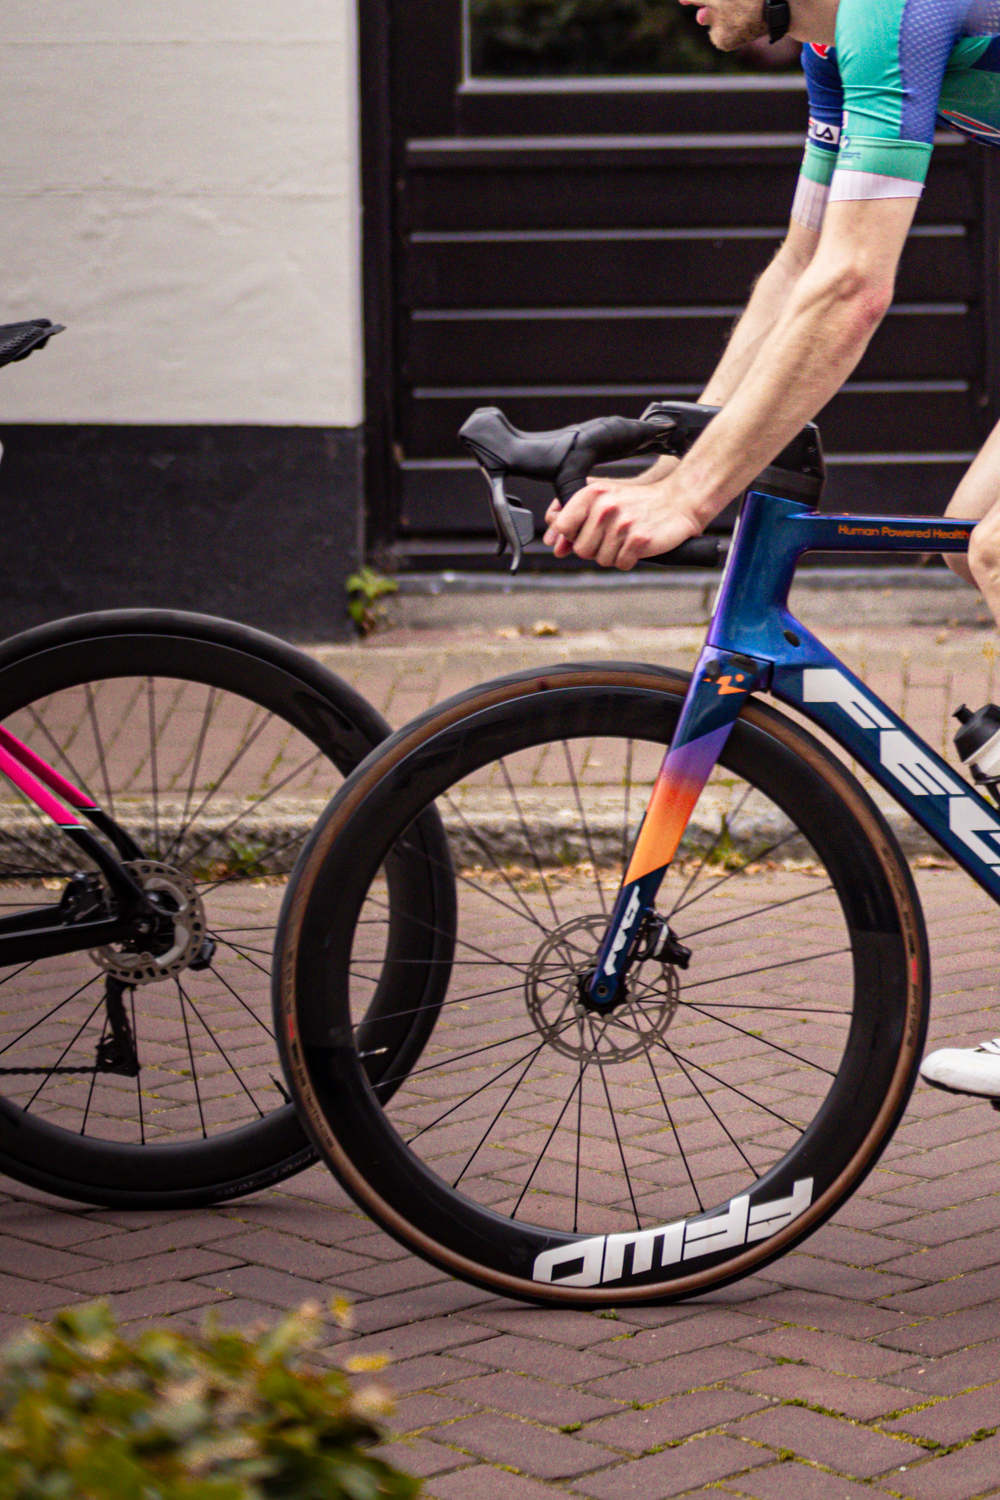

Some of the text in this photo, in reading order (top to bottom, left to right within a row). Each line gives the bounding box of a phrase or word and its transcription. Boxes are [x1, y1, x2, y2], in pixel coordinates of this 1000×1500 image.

[838, 524, 880, 537] Human
[881, 526, 931, 540] Powered
[532, 1177, 814, 1287] FFWD
